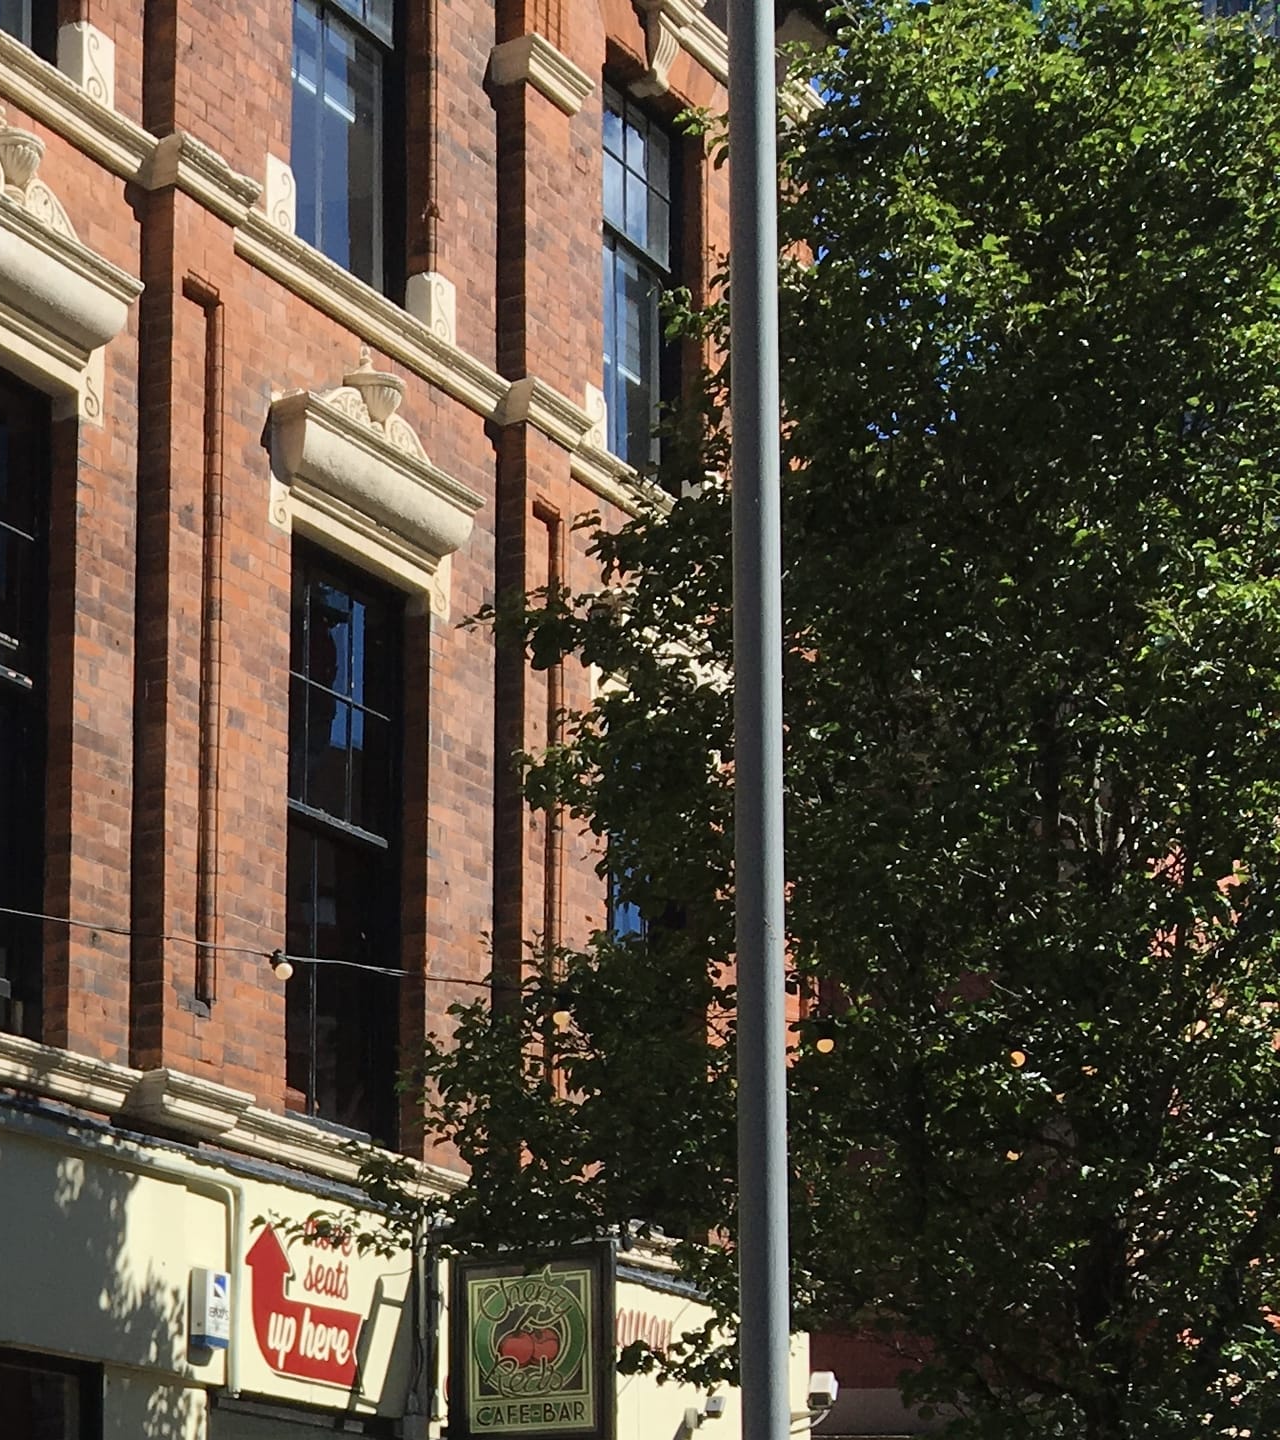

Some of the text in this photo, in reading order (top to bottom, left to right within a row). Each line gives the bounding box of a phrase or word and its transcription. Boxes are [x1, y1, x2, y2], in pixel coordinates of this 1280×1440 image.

[304, 1256, 349, 1301] seats
[480, 1280, 572, 1327] Cherry
[268, 1312, 297, 1370] up
[299, 1307, 350, 1366] here
[484, 1354, 563, 1397] Reds
[476, 1402, 585, 1426] CAFE-BAR
